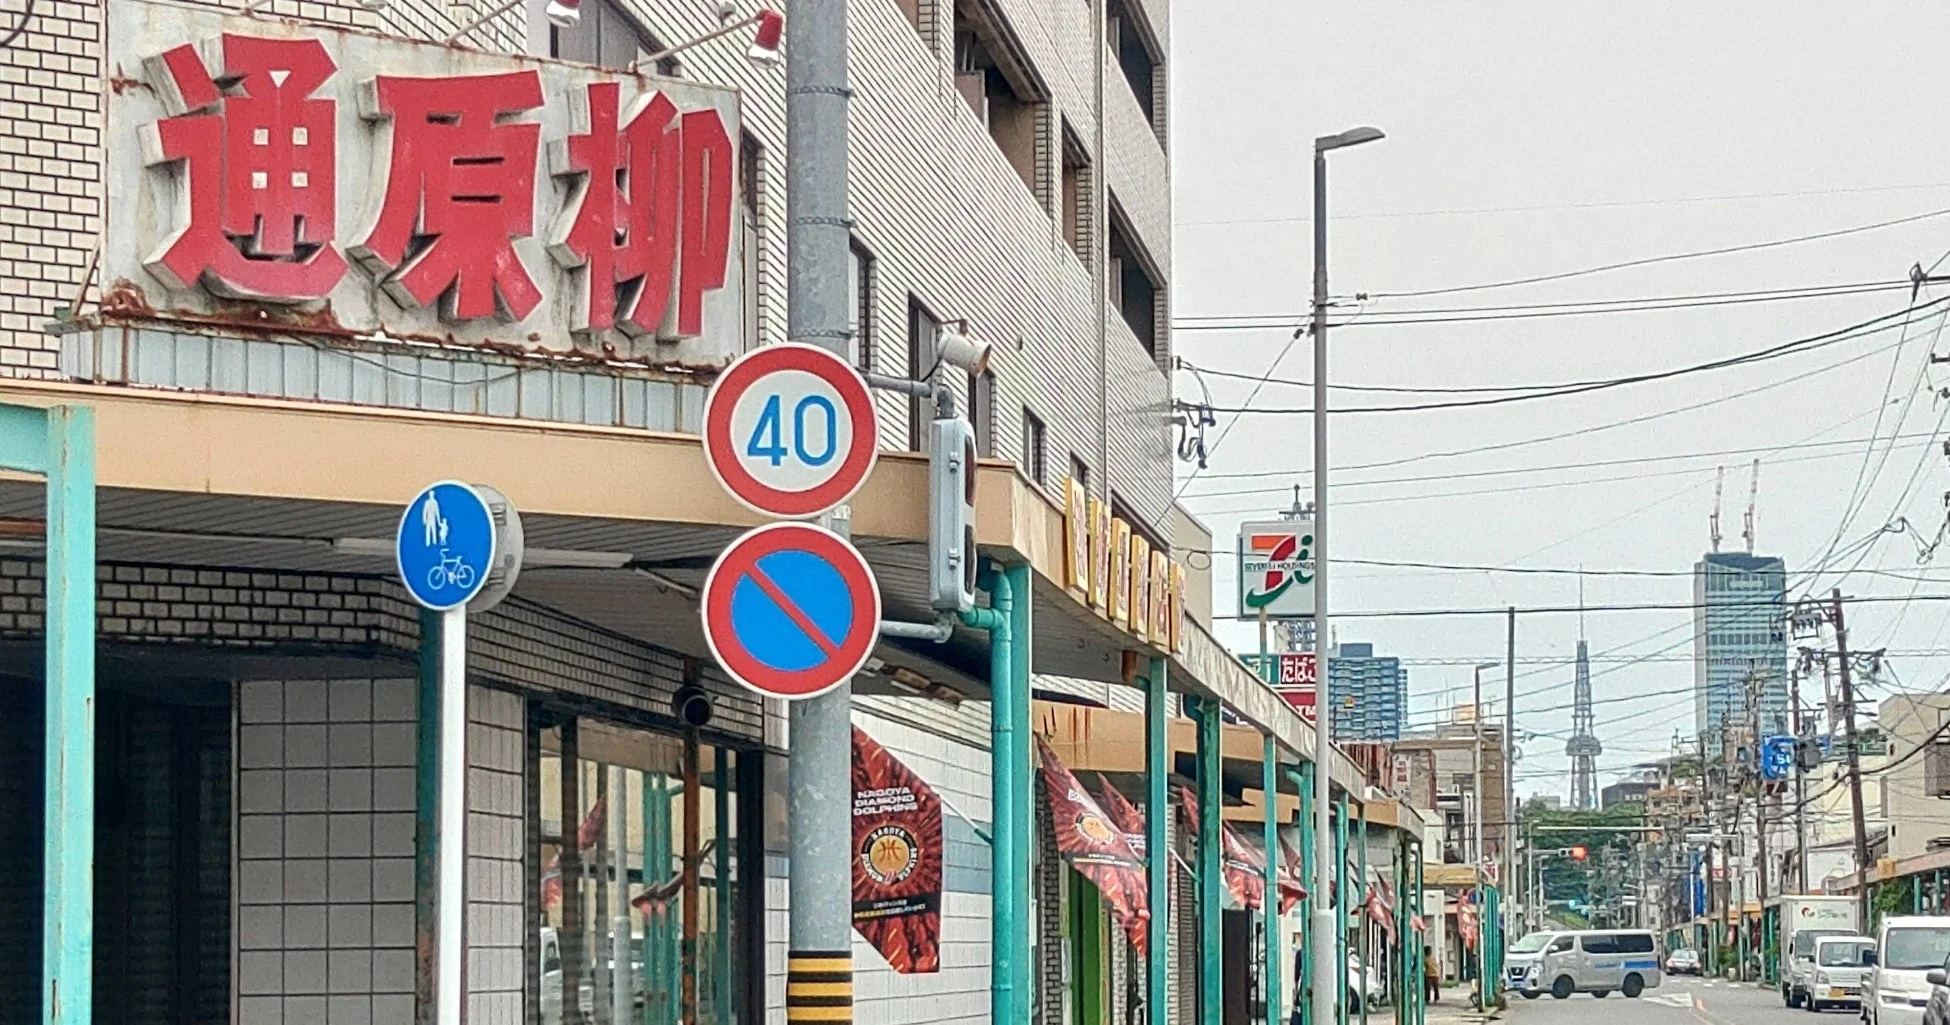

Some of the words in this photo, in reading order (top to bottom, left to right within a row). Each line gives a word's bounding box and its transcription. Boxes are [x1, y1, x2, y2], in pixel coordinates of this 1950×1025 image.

[747, 395, 837, 467] 40
[857, 786, 911, 799] NAGOYA
[855, 794, 915, 808] DIAMOND
[853, 802, 918, 816] DOLPHINS
